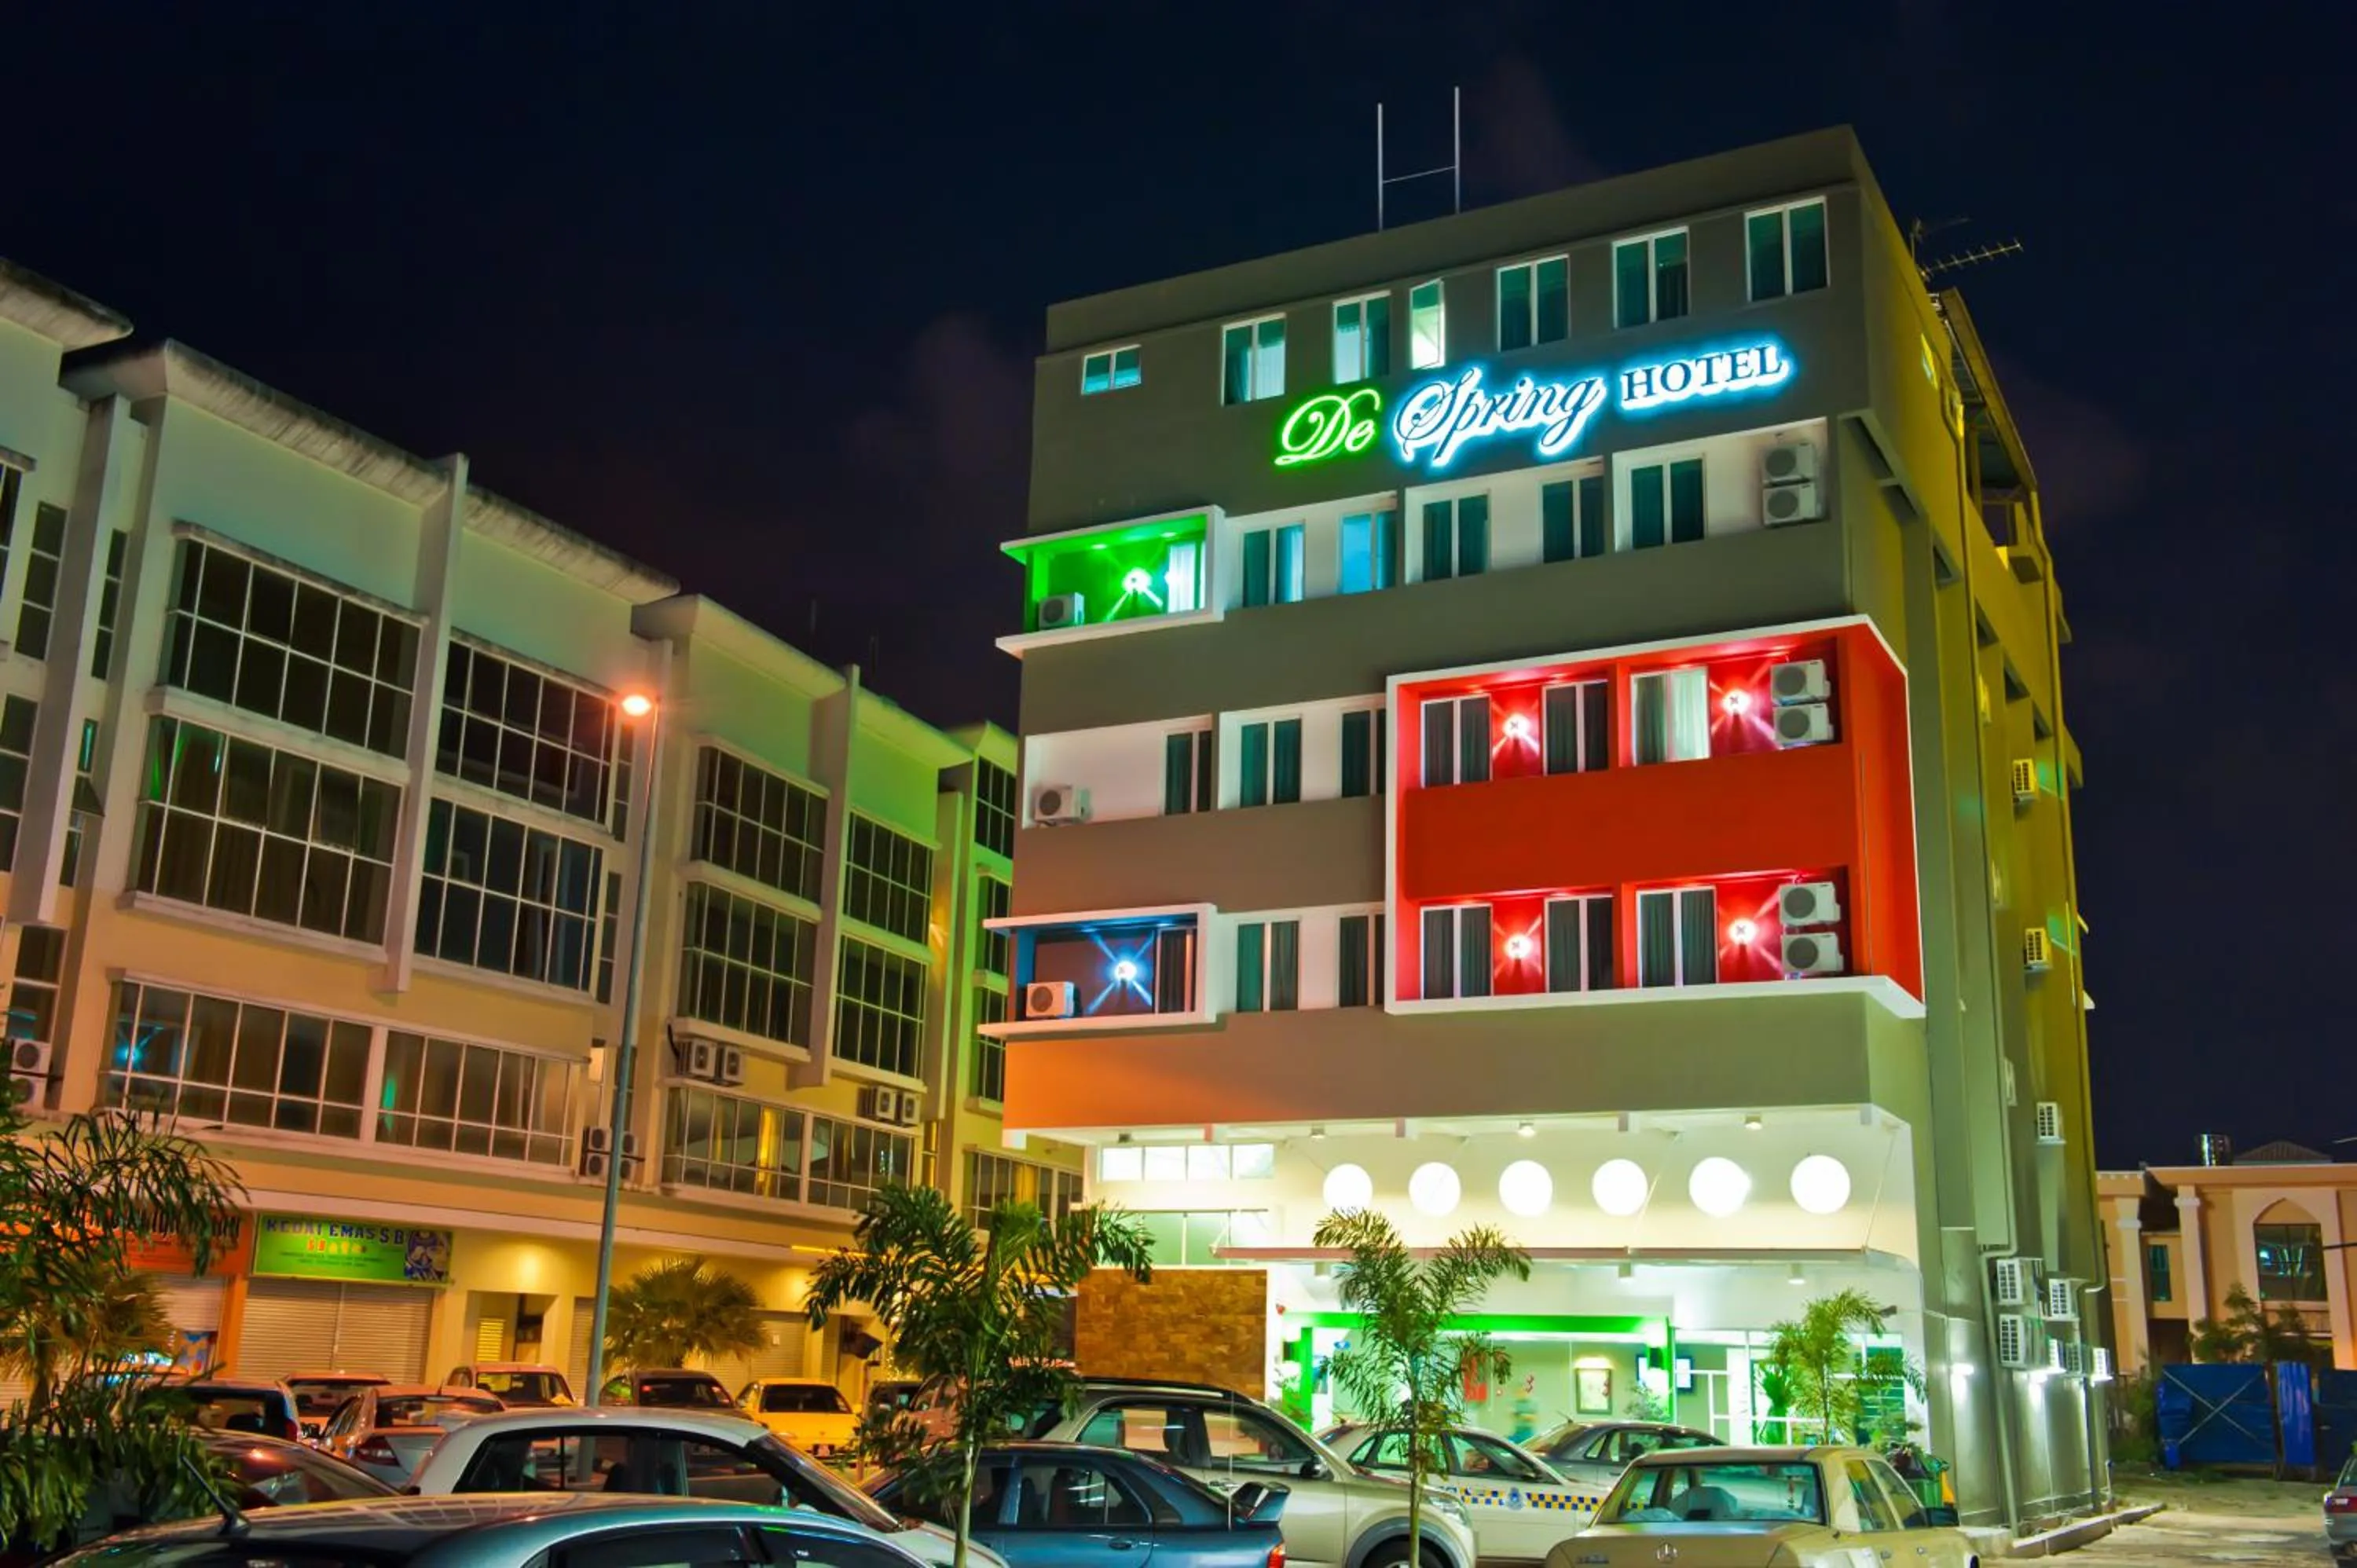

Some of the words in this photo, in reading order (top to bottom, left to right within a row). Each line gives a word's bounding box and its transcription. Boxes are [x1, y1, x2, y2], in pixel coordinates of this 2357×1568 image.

[1274, 389, 1380, 466] De
[1394, 367, 1606, 464] Spring
[1622, 343, 1786, 405] HOTEL
[328, 1222, 376, 1240] EMAS
